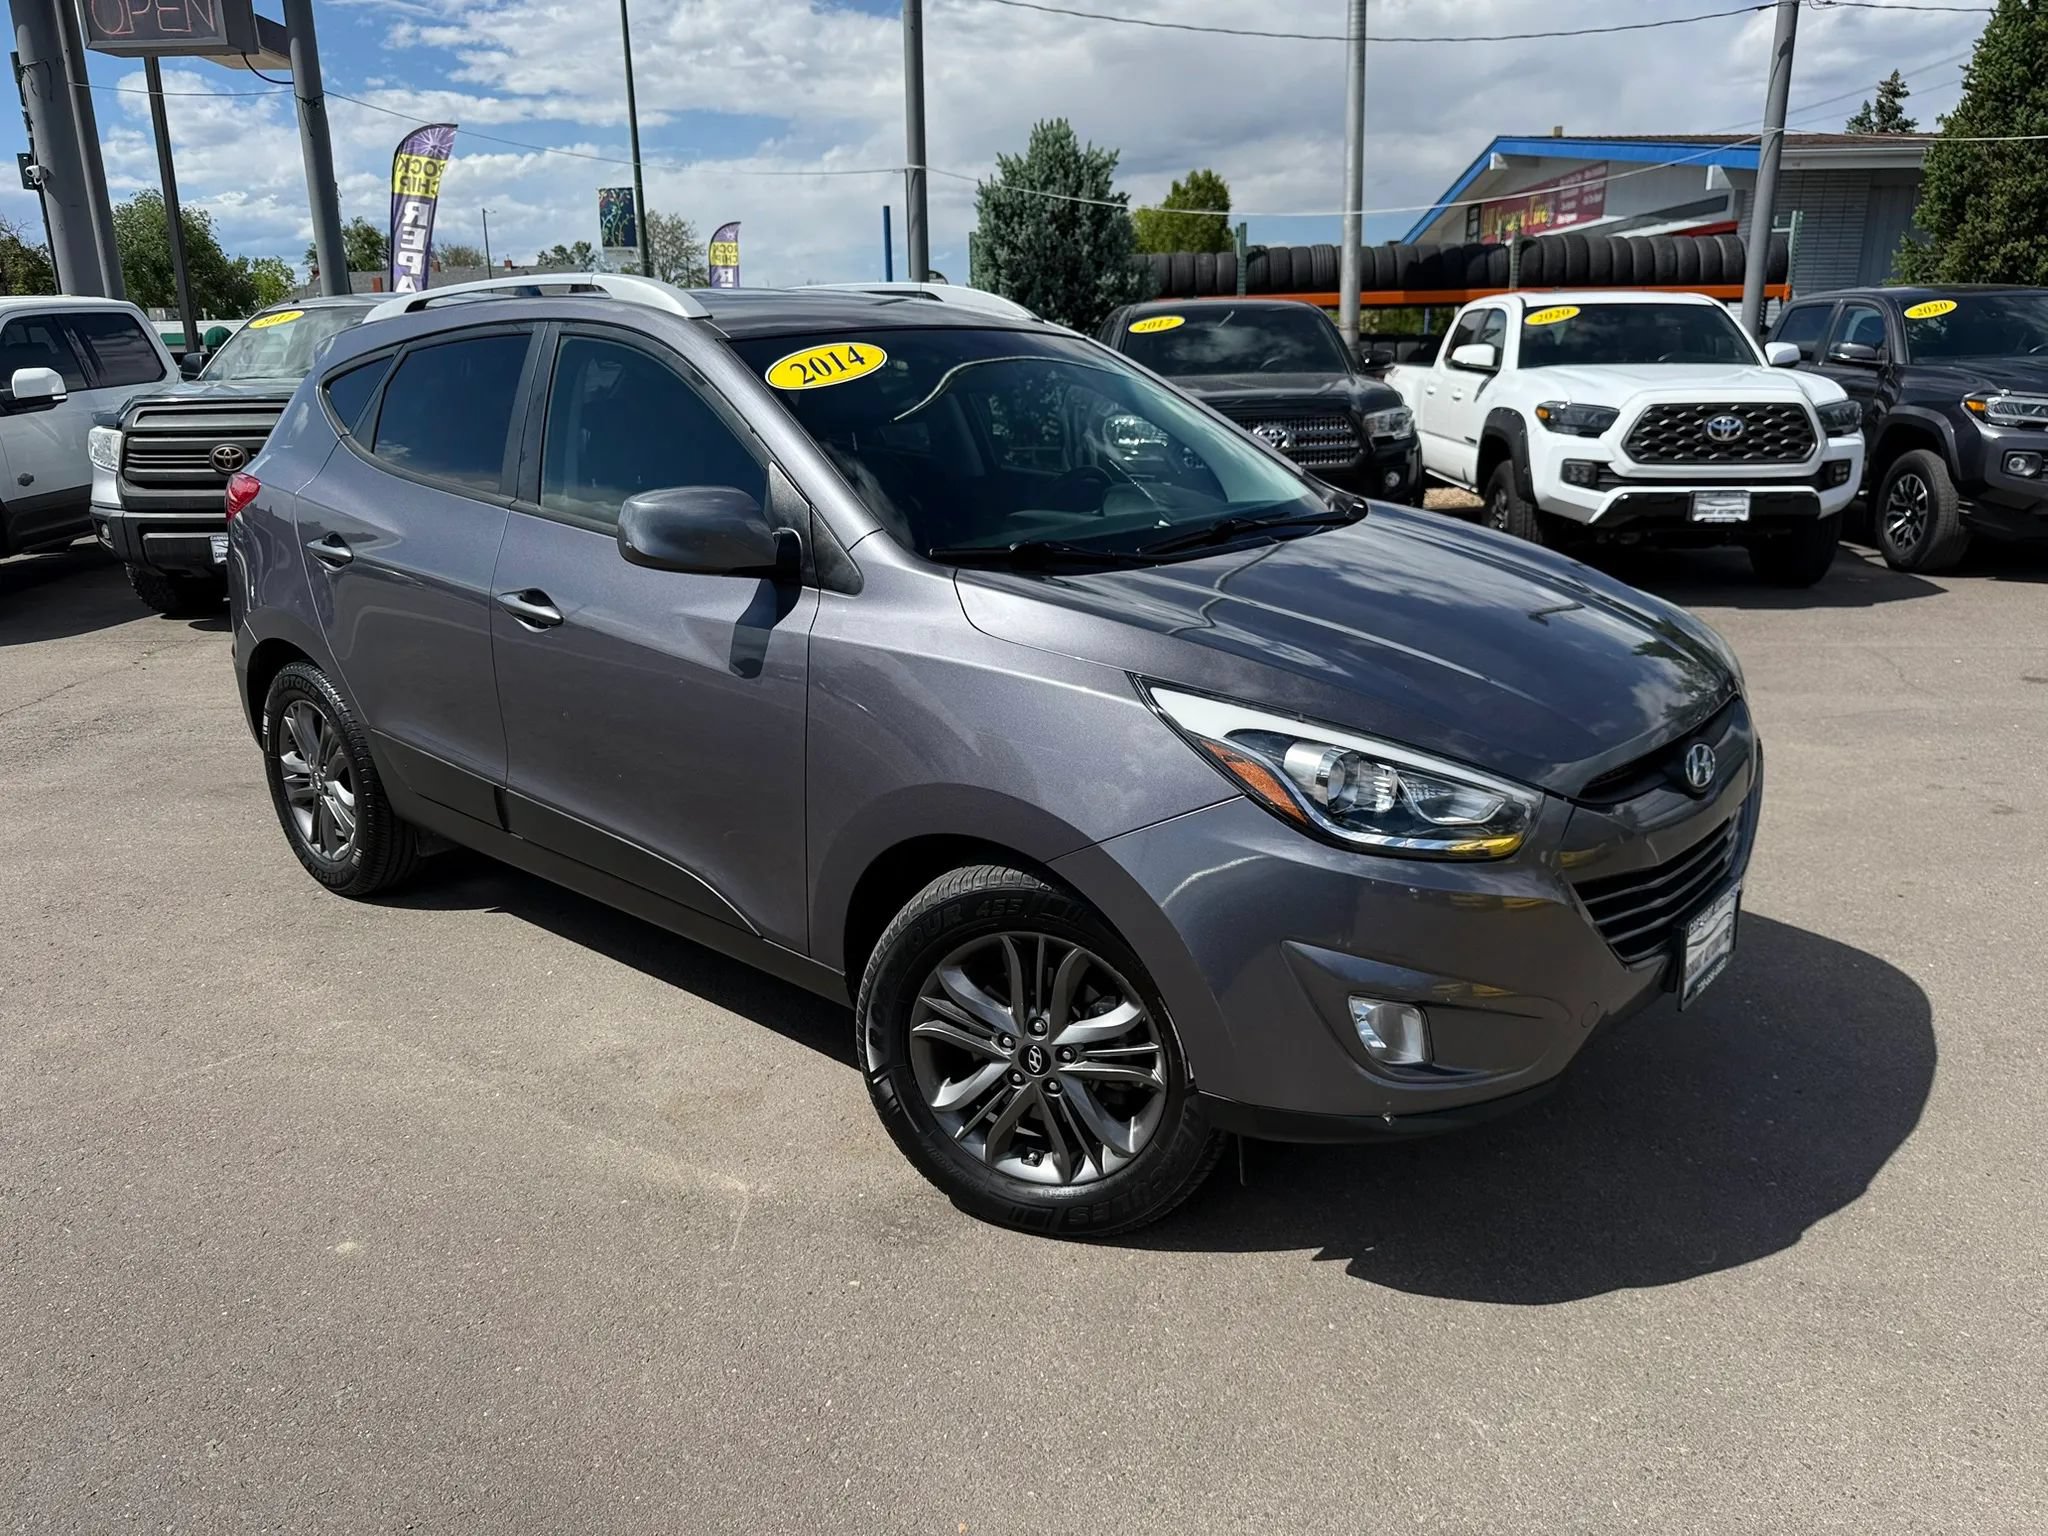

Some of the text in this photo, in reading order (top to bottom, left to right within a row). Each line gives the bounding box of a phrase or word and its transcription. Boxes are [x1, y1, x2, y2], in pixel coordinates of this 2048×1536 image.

[1537, 308, 1570, 322] 2020
[1915, 302, 1948, 316] 2020
[1139, 318, 1173, 331] 2017
[789, 345, 866, 385] 2014
